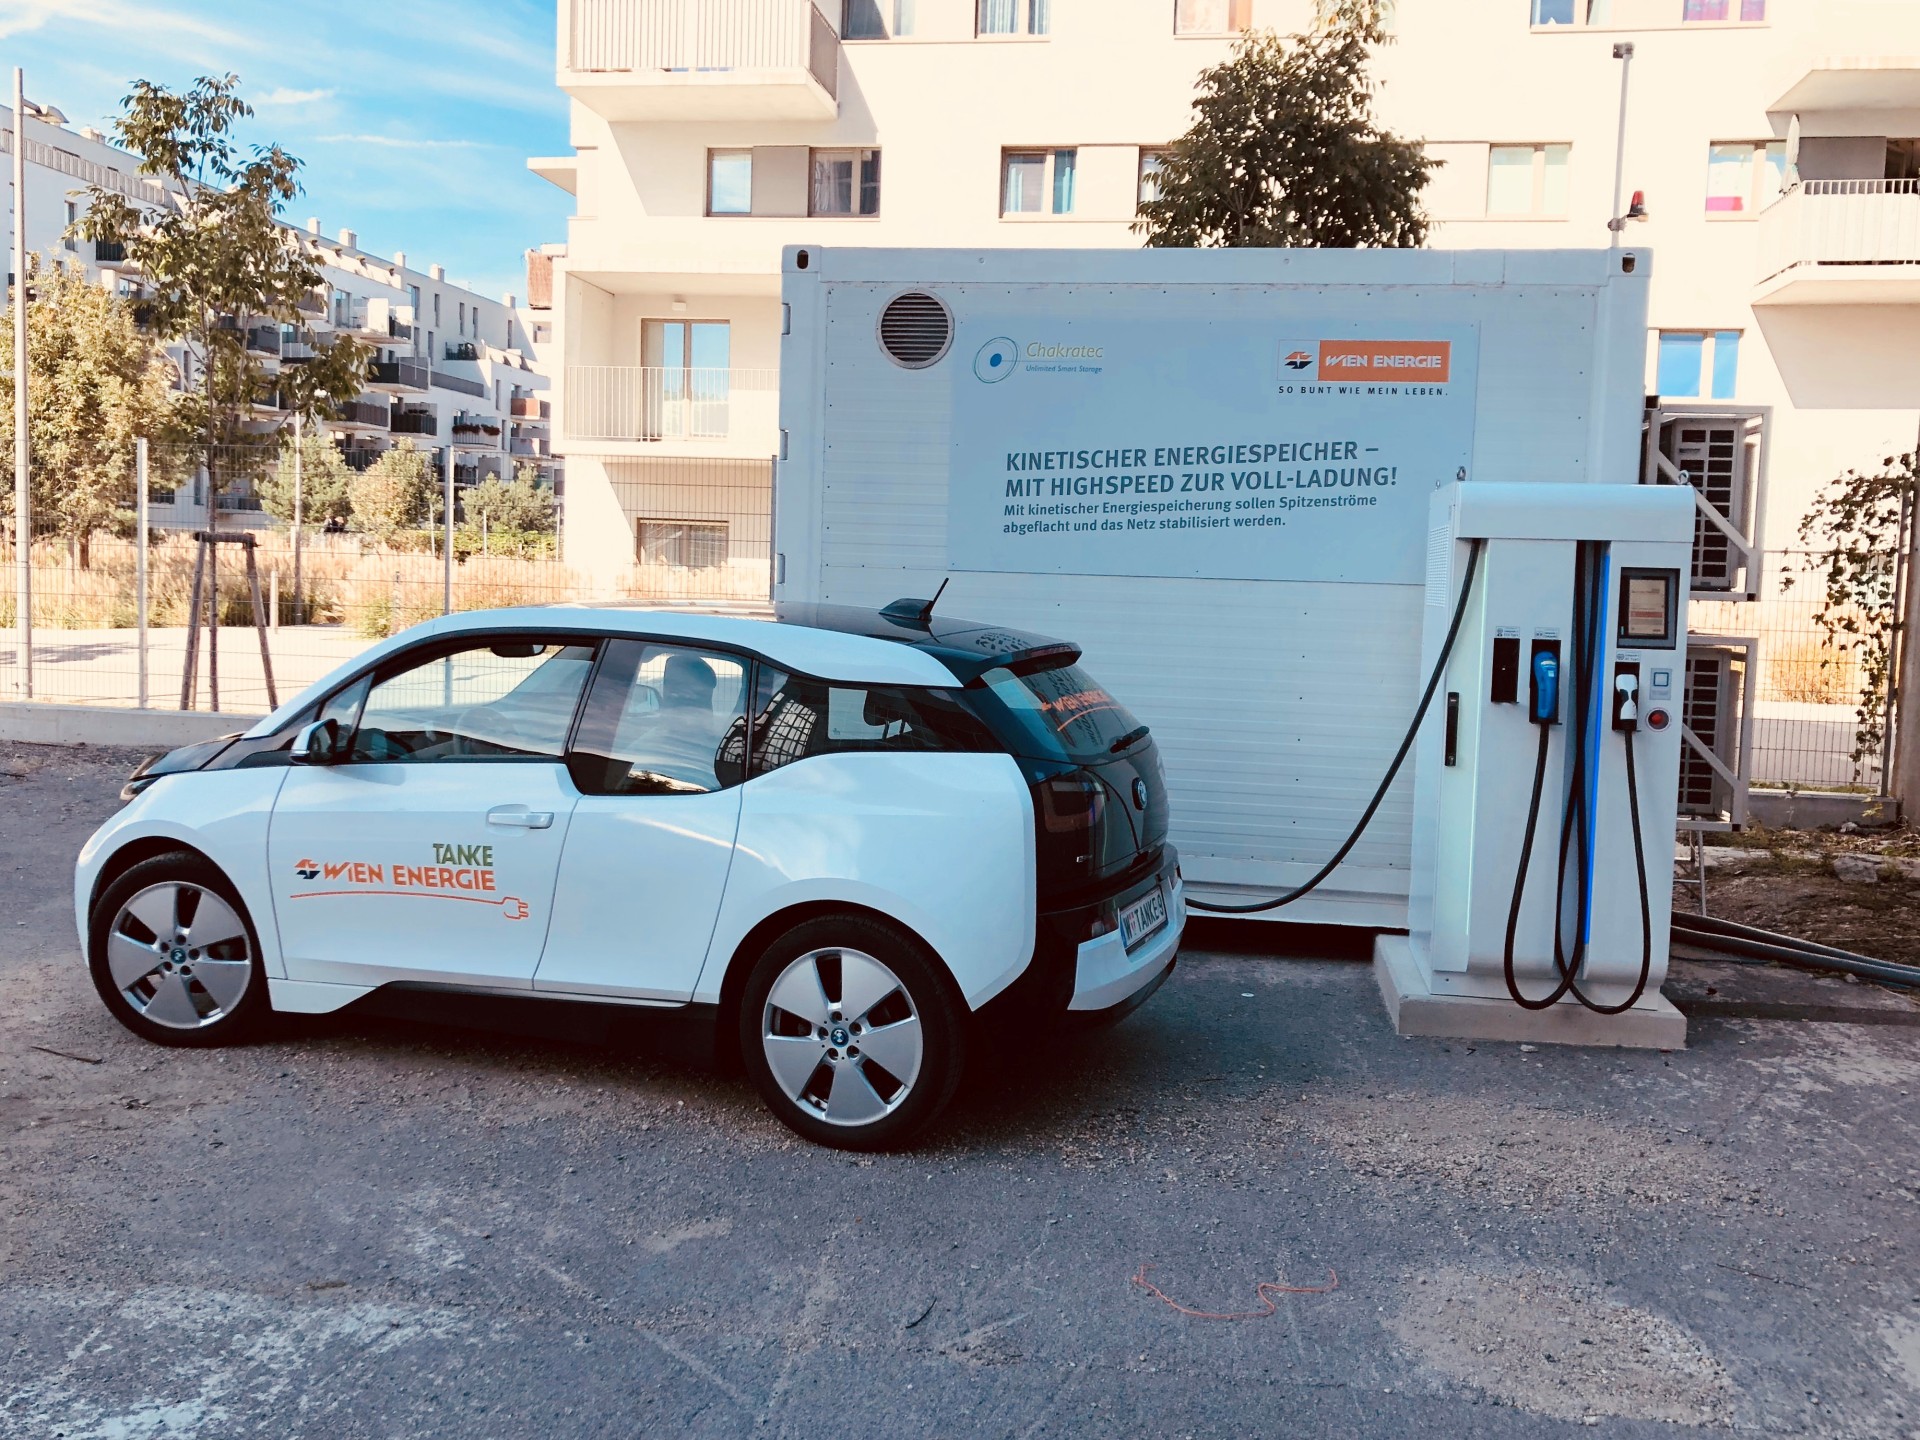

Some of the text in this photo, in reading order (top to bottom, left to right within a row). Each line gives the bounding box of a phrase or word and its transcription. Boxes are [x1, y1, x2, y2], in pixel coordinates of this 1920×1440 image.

[1026, 342, 1104, 358] Chakratec
[1325, 353, 1442, 369] WIEN ENERGIE
[1025, 364, 1103, 374] Unlimited Smart Storage
[1278, 385, 1448, 396] SO BUNT WIE MEIN LEBEN.
[1006, 448, 1147, 472] KINETISCHER
[1154, 441, 1359, 467] ENERGIESPEICHER
[1005, 466, 1398, 498] MIT HIGHSPEED ZUR VOLL-LADUNG!
[1004, 494, 1378, 517] Mit kinetischer Energiespeicherung sollen Spitzenströme
[1002, 514, 1286, 536] abgeflacht und das Netz stabilisiert werden.
[432, 843, 494, 866] TANKE
[323, 861, 496, 891] WIEN ENERGIE
